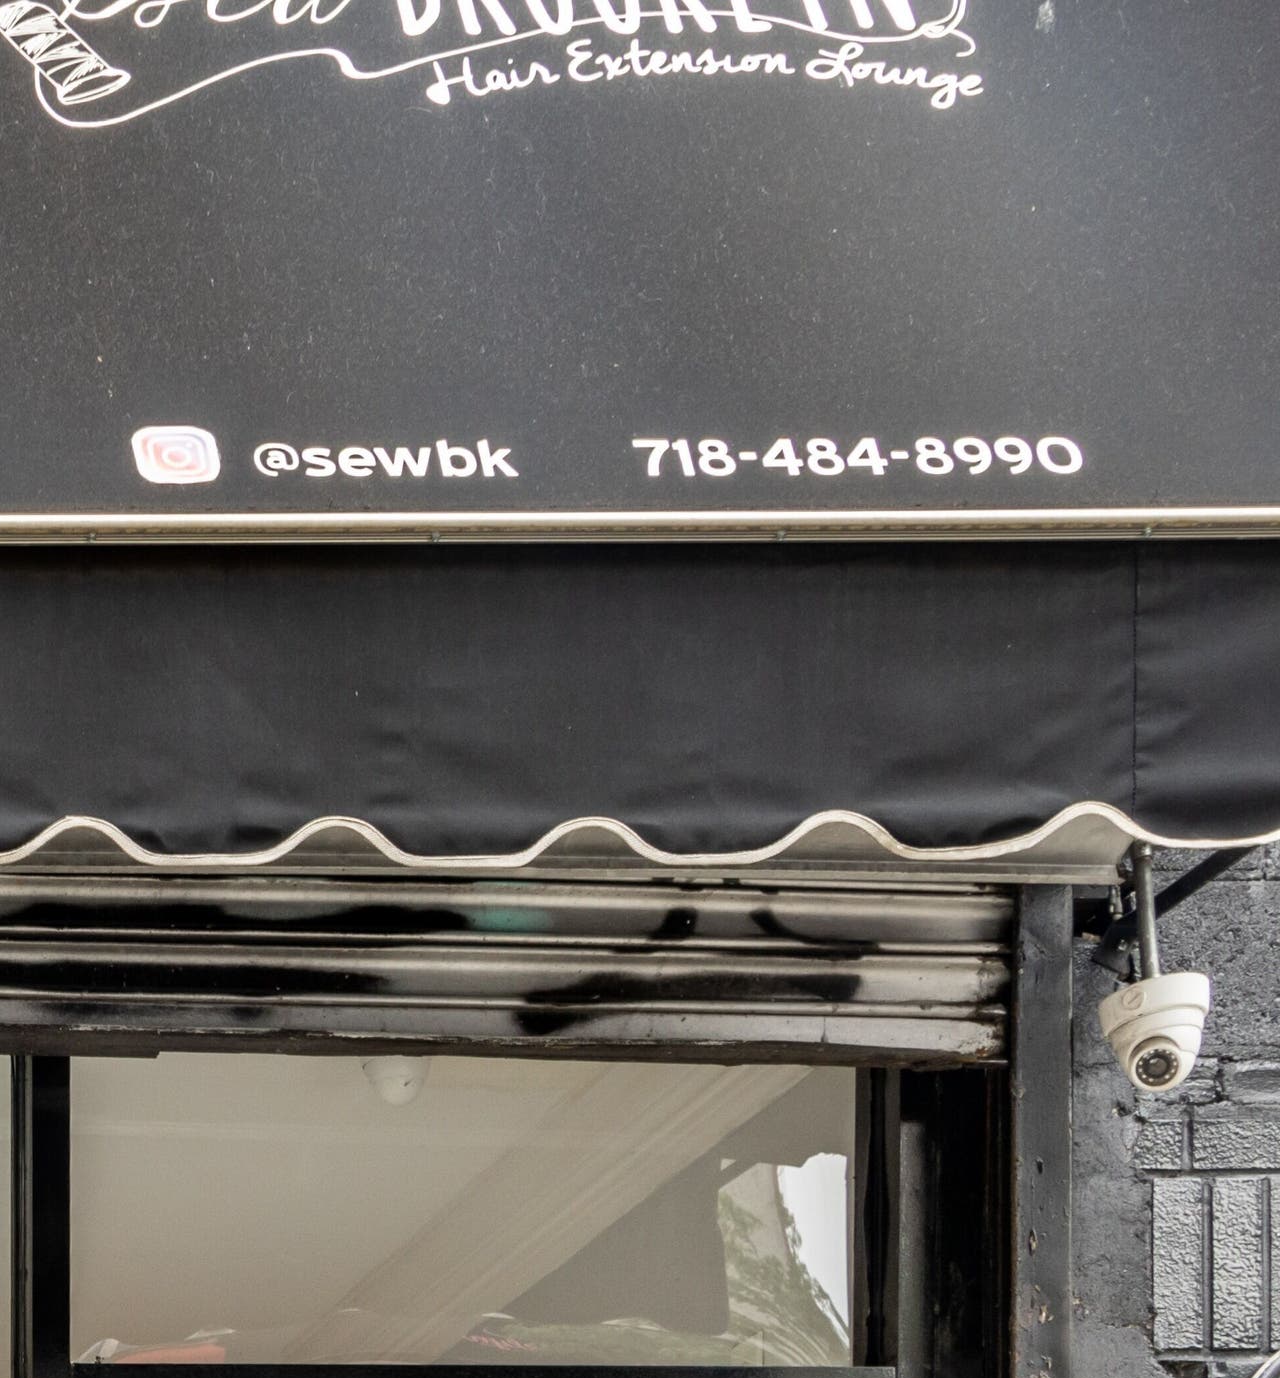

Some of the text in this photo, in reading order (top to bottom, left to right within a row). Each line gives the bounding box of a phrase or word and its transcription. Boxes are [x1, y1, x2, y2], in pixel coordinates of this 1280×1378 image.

[427, 41, 985, 109] Hair Extension Lounge
[252, 438, 520, 479] @sewbk
[632, 436, 1084, 478] 718-484-8990
